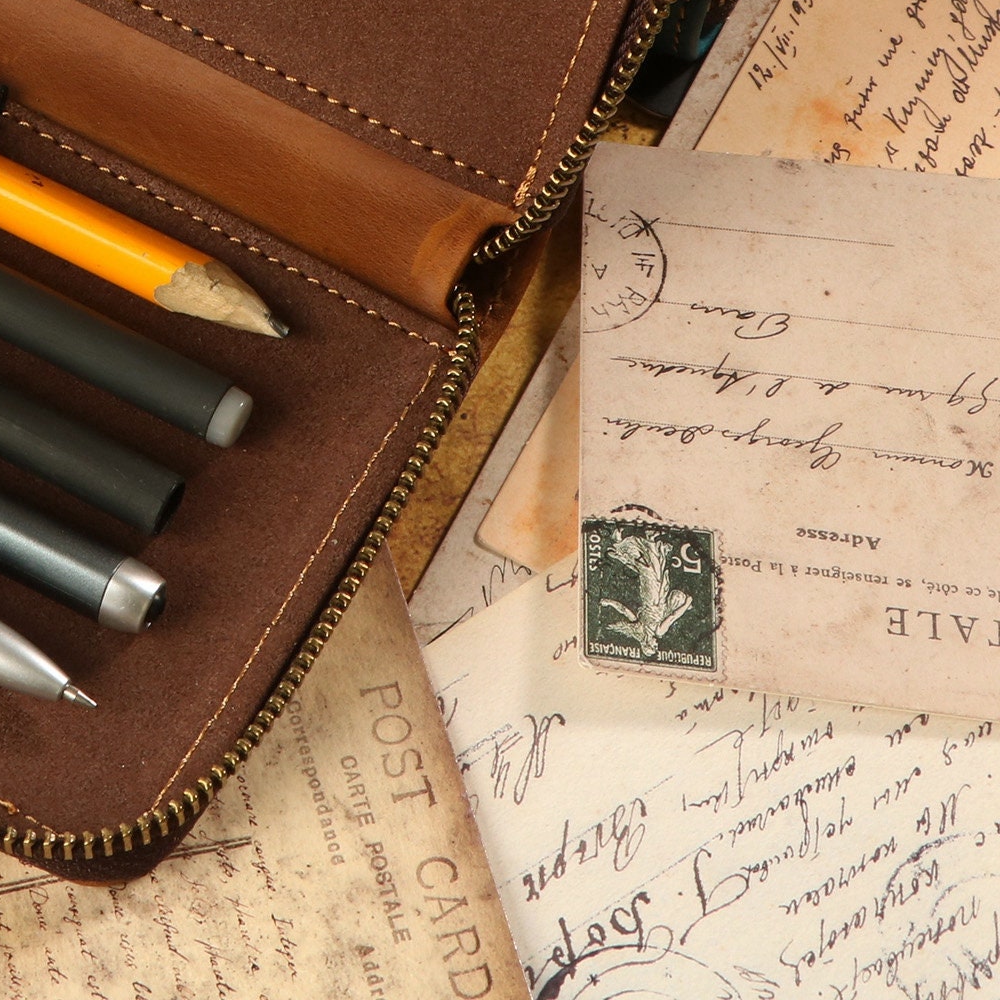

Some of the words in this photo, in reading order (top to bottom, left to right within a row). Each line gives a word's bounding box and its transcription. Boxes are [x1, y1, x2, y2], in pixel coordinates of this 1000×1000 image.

[795, 527, 882, 551] Adresse
[588, 528, 602, 573] OSTES
[720, 555, 763, 574] Poste
[770, 561, 784, 577] la
[790, 564, 799, 580] à
[804, 566, 889, 587] renseigner
[895, 576, 913, 589] se
[588, 641, 642, 660] FRANÇAISE
[286, 699, 346, 868] Correspondance
[354, 943, 385, 1000] Addr
[339, 754, 377, 829] CARTE
[364, 839, 413, 946] POSTALE
[359, 680, 438, 810] POST
[415, 855, 494, 1000] CARD
